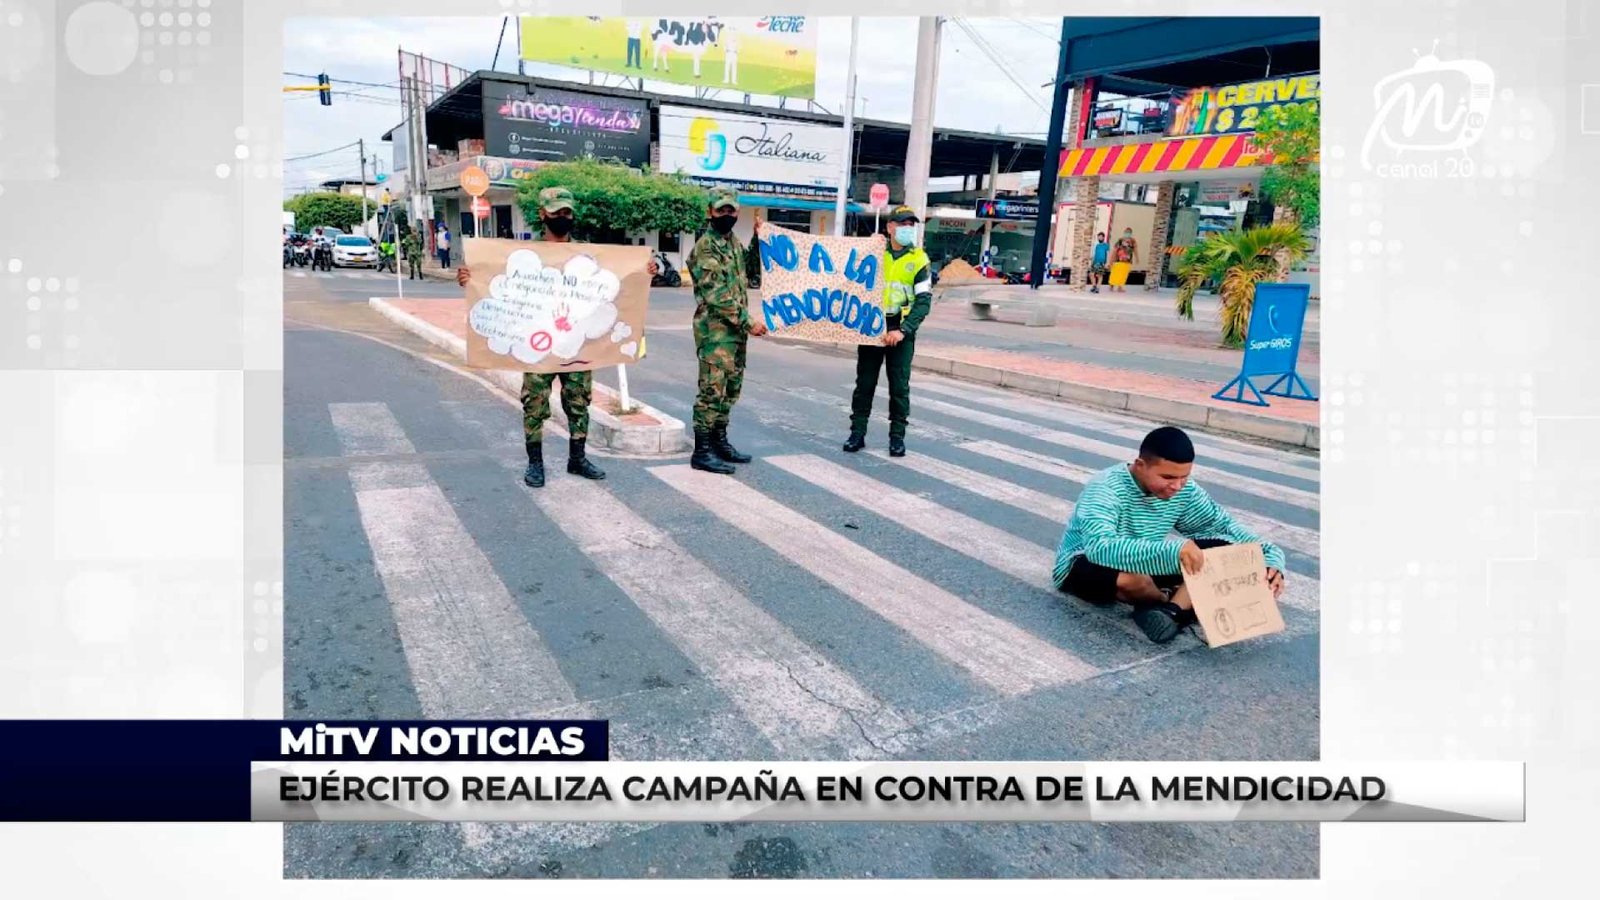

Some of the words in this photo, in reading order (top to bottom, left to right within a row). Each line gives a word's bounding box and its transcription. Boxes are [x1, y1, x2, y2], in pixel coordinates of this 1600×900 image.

[1217, 75, 1320, 107] CERVE
[735, 122, 826, 162] Italiana
[939, 219, 966, 228] RICOH
[759, 233, 799, 272] NO
[808, 242, 836, 274] A
[843, 247, 879, 291] LA
[762, 288, 885, 337] MENDICIDAD
